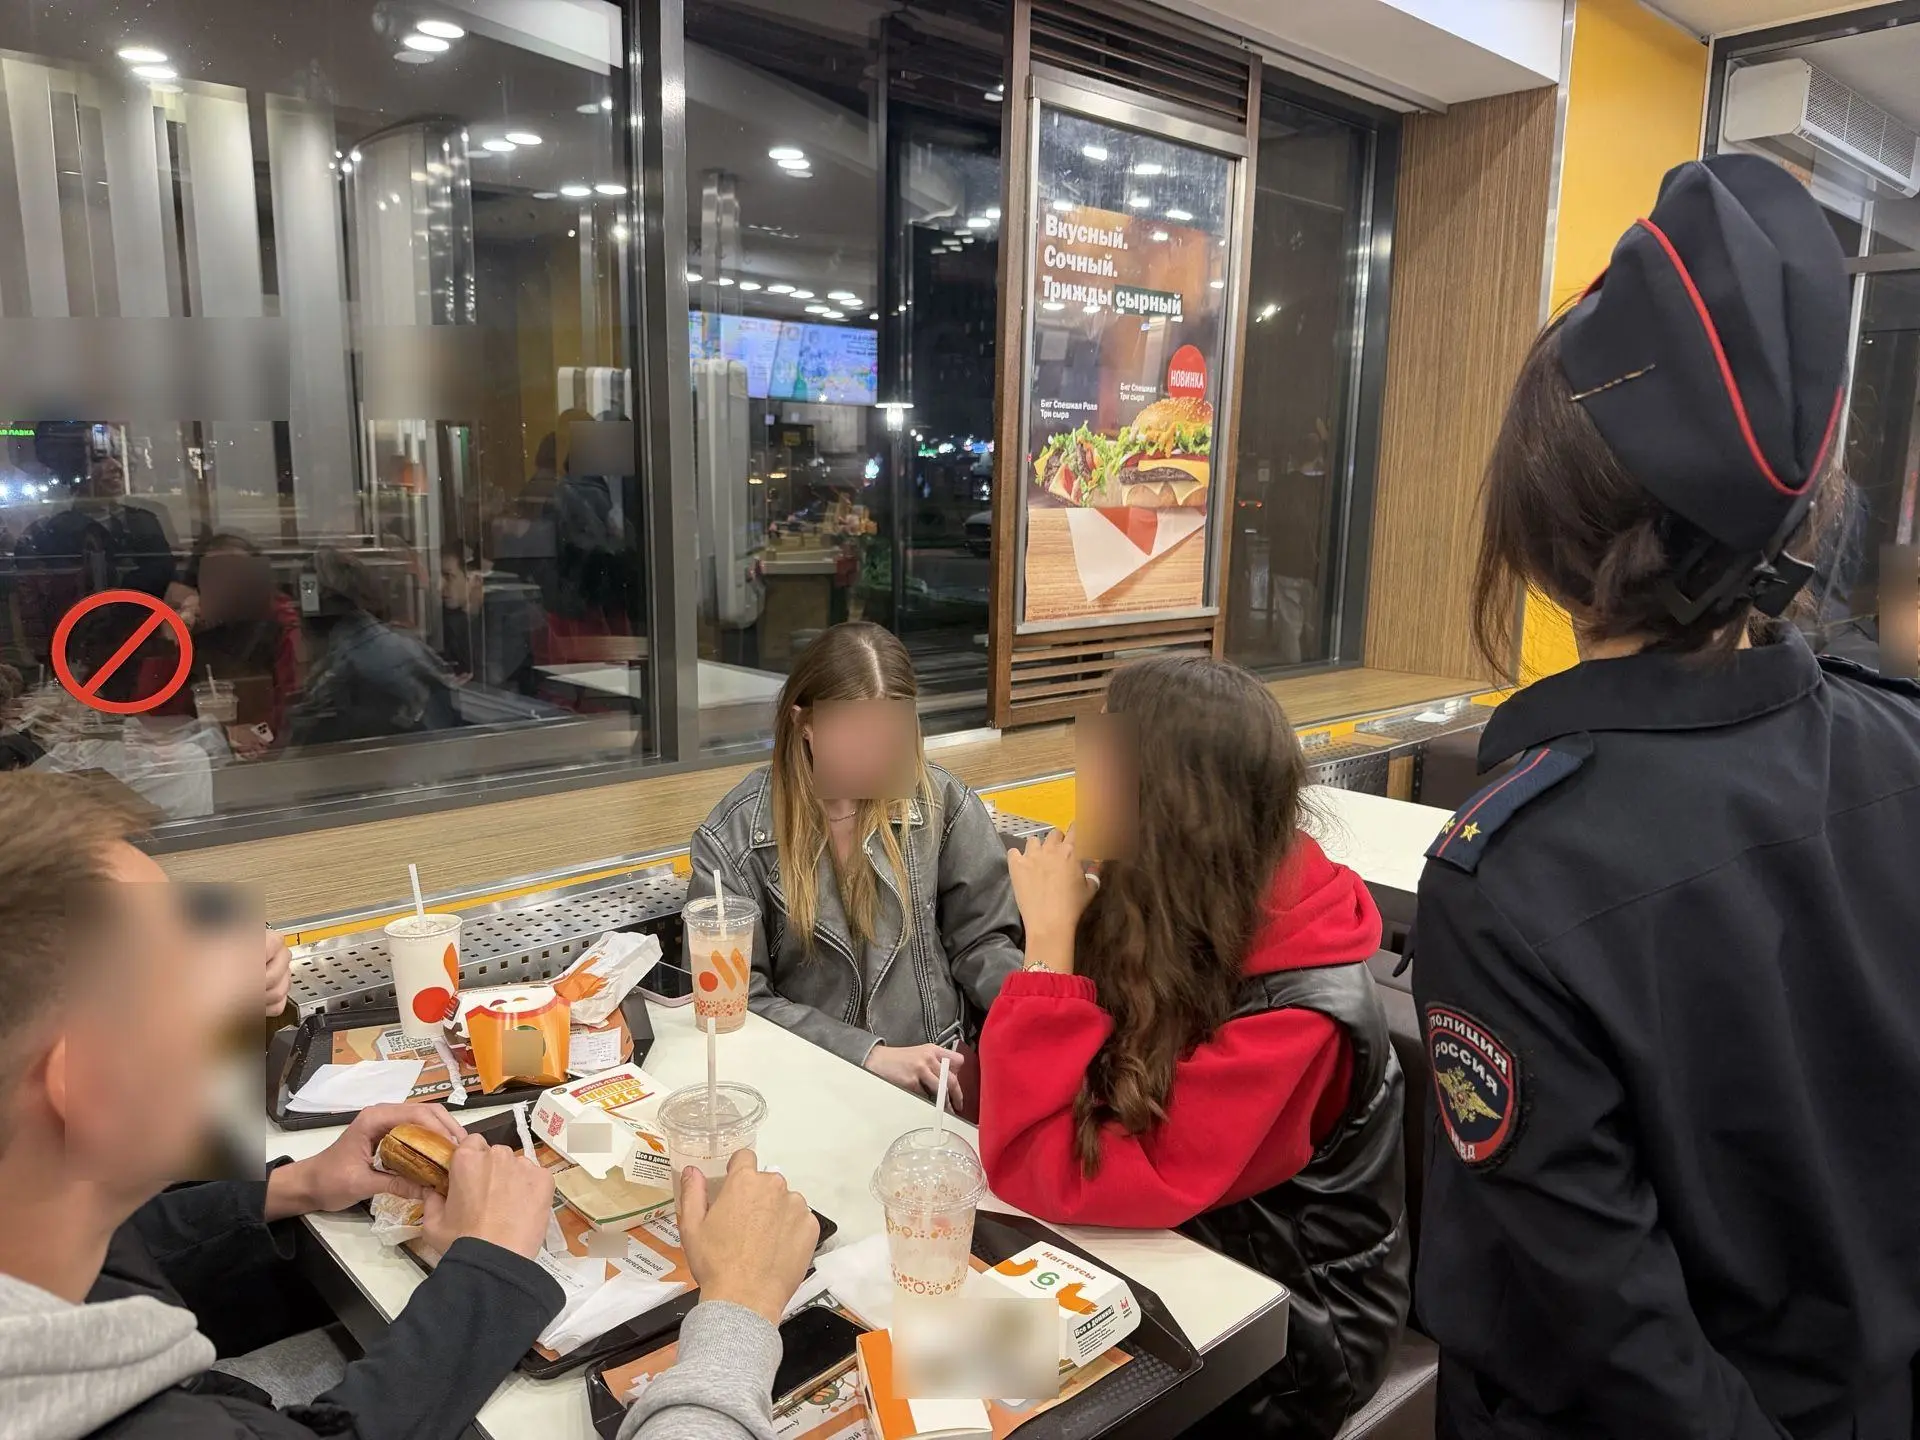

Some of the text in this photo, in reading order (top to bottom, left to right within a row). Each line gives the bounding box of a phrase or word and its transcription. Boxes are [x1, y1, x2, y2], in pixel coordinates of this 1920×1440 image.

[1045, 214, 1128, 250] Вкусный.
[1044, 245, 1118, 277] Сочный.
[1042, 275, 1182, 315] Трижды сырный
[1120, 382, 1156, 393] Биг Спешиал
[1170, 369, 1204, 389] НОВИНКА
[1040, 399, 1098, 411] Биг Спешиал Ролл
[1120, 392, 1145, 402] Три сыра
[1040, 410, 1069, 420] Три сыра
[1430, 1014, 1507, 1076] ПОЛИЦИЯ
[1435, 1041, 1498, 1096] РОССИЯ
[1450, 1126, 1476, 1160] МВД
[1037, 1271, 1060, 1286] 6
